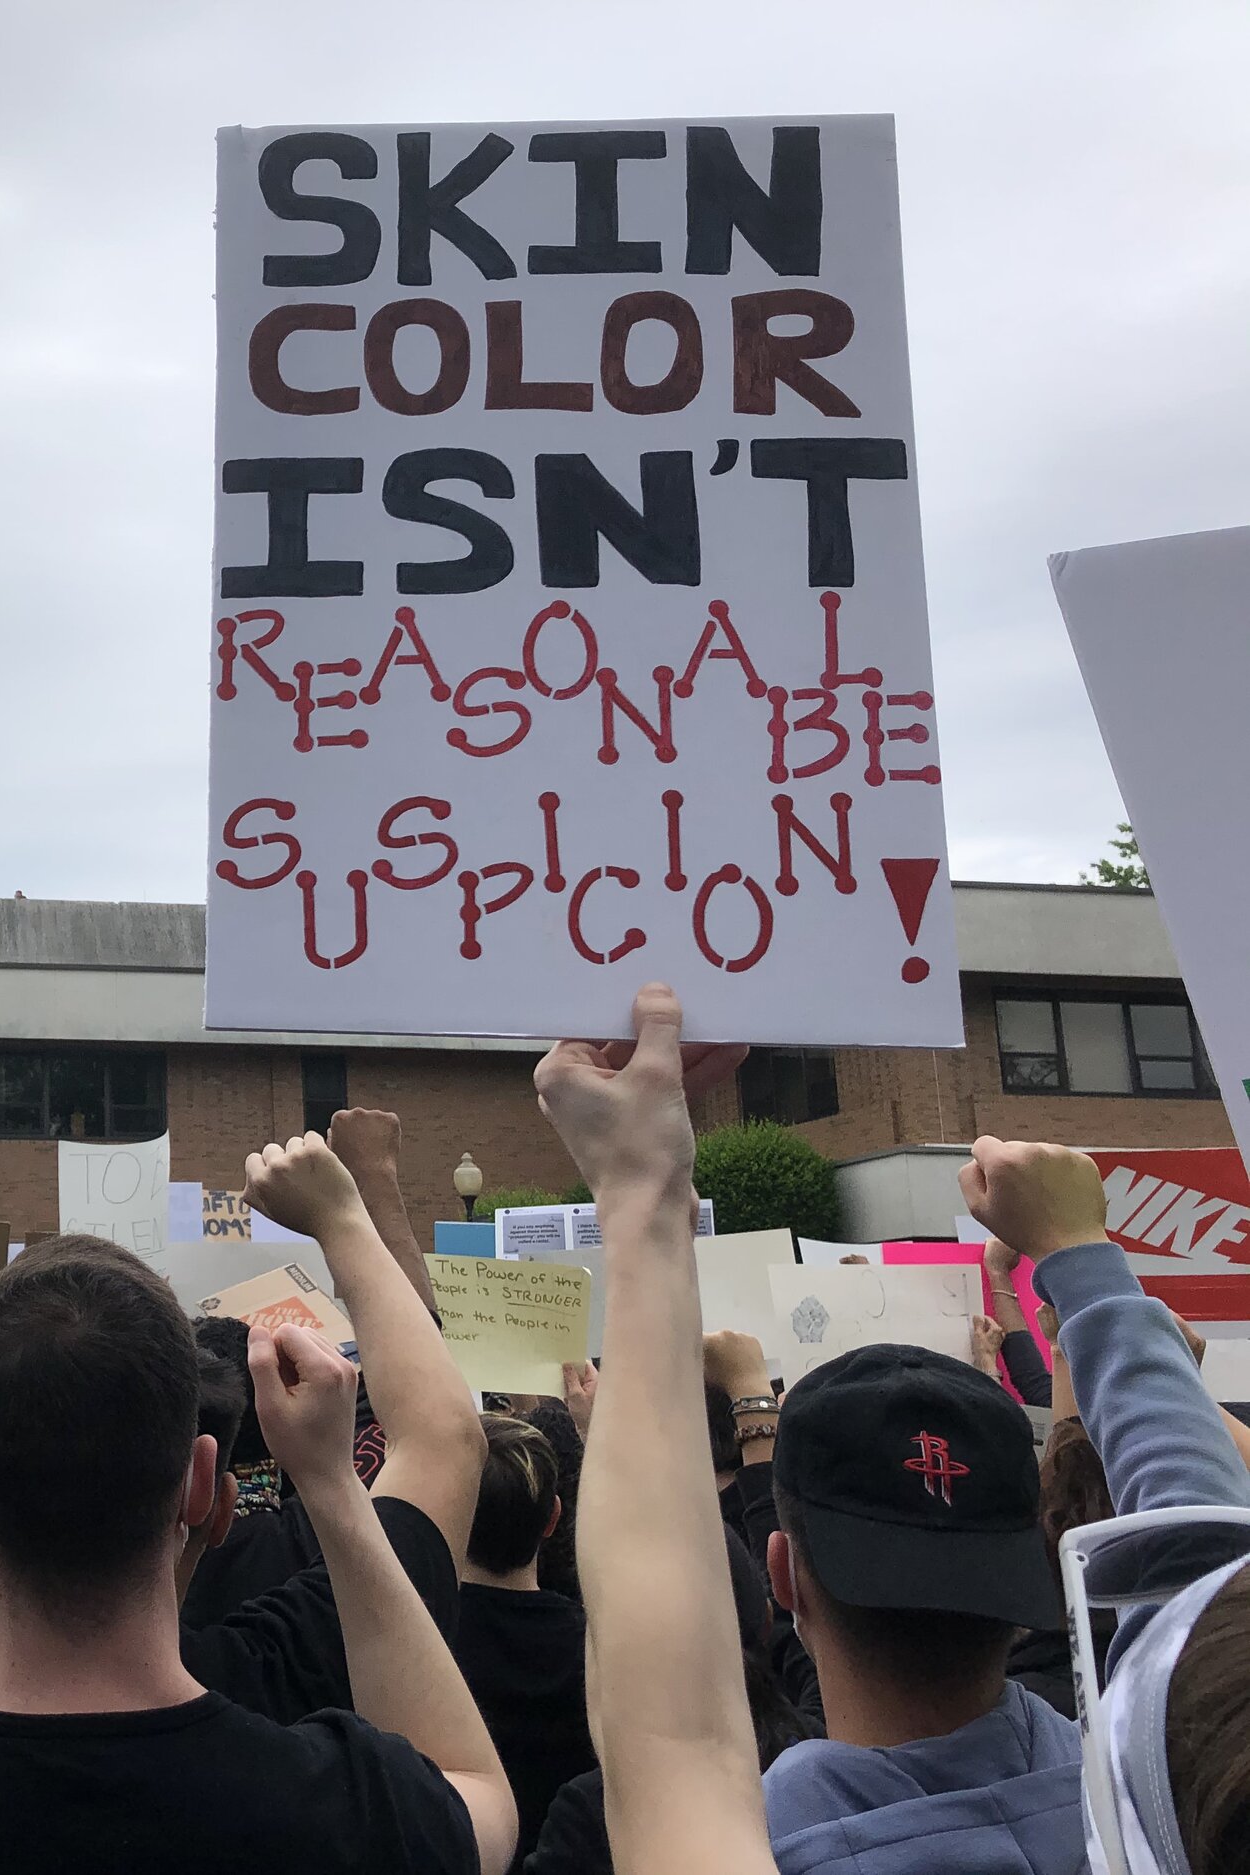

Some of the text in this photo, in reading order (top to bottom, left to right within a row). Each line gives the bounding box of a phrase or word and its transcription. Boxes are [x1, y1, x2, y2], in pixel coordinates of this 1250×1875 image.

[258, 126, 824, 287] SKIN
[249, 288, 862, 418] COLOR
[220, 437, 909, 598] ISN'T
[216, 591, 942, 786] REASONABLE
[215, 789, 940, 984] SUSPICION!
[435, 1260, 582, 1290] The Power of the
[1102, 1165, 1250, 1257] NIKE
[435, 1304, 571, 1333] than the People in
[477, 1284, 490, 1296] is
[501, 1286, 582, 1308] STRONGER
